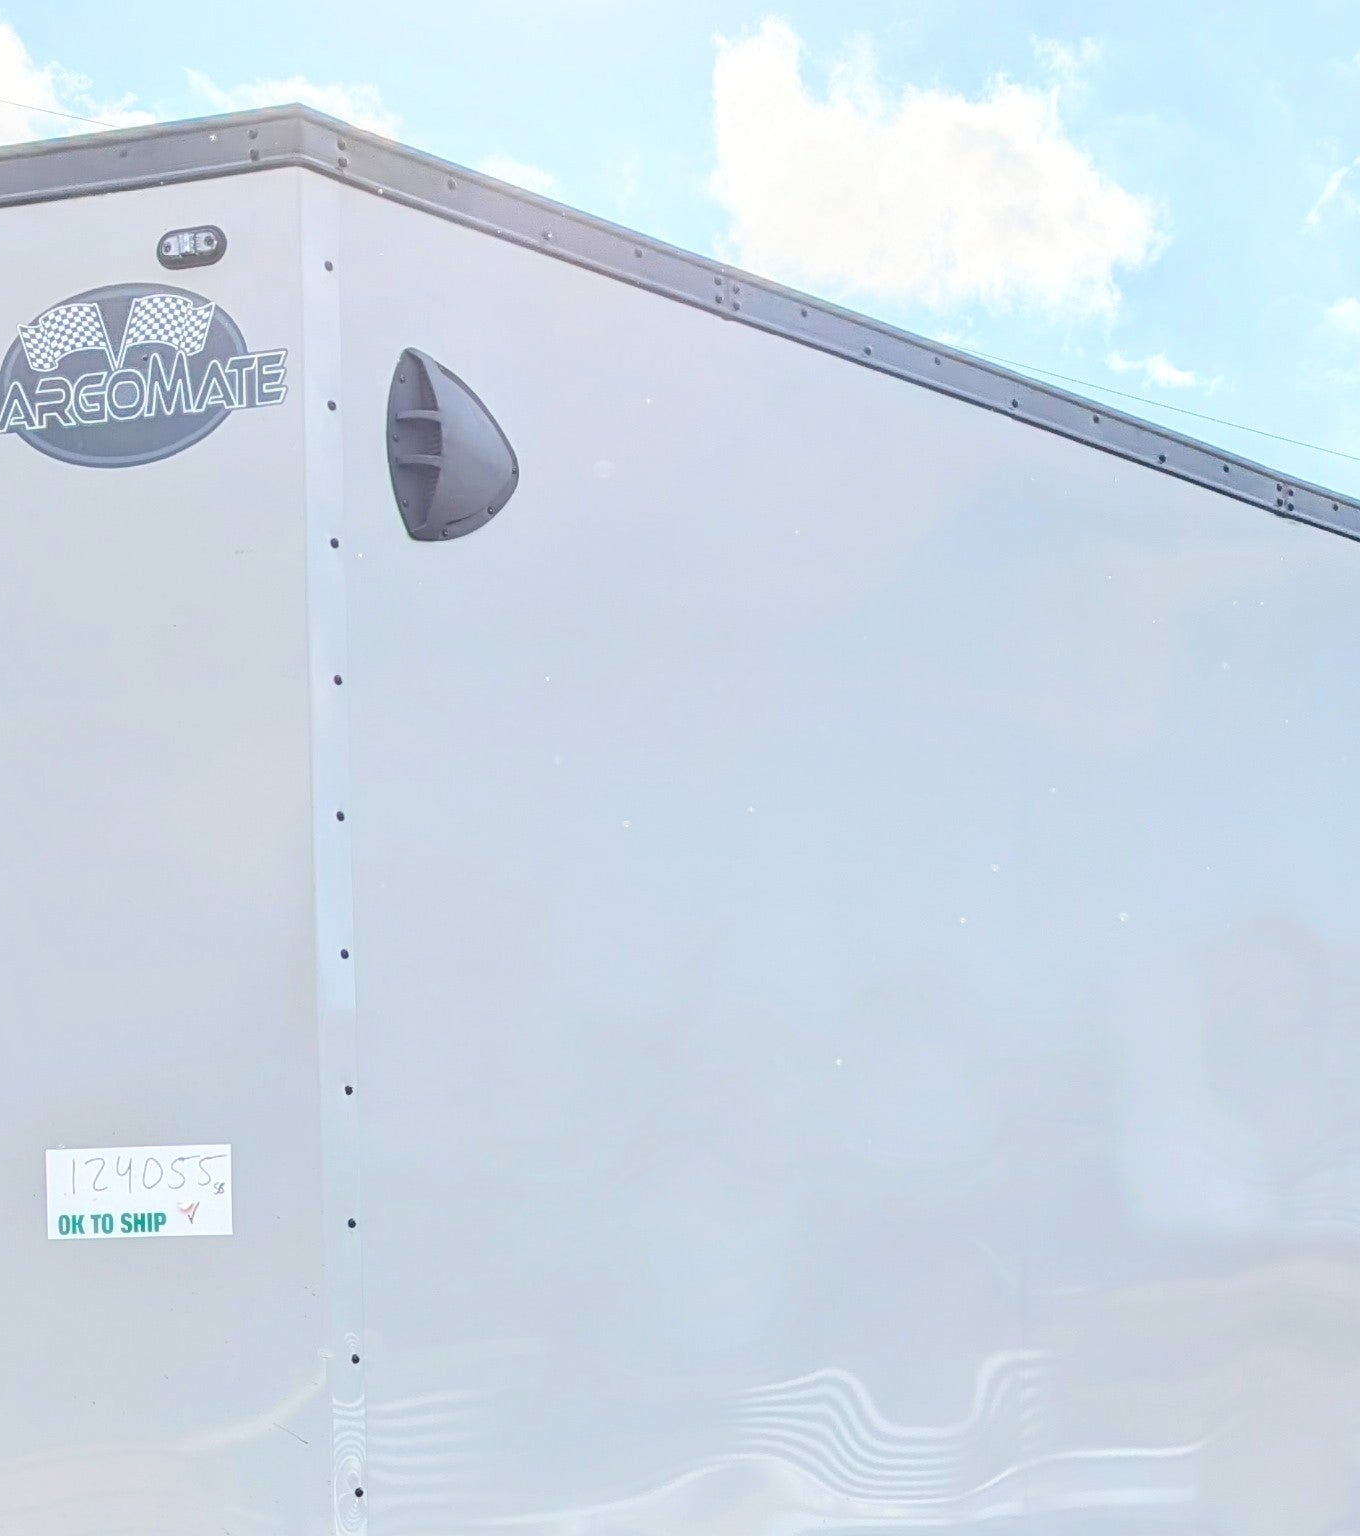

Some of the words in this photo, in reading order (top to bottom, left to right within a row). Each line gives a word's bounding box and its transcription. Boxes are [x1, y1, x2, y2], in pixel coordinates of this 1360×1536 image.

[72, 1154, 228, 1195] 124055
[58, 1213, 86, 1236] OK
[90, 1212, 114, 1235] TO
[120, 1211, 167, 1234] SHIP
